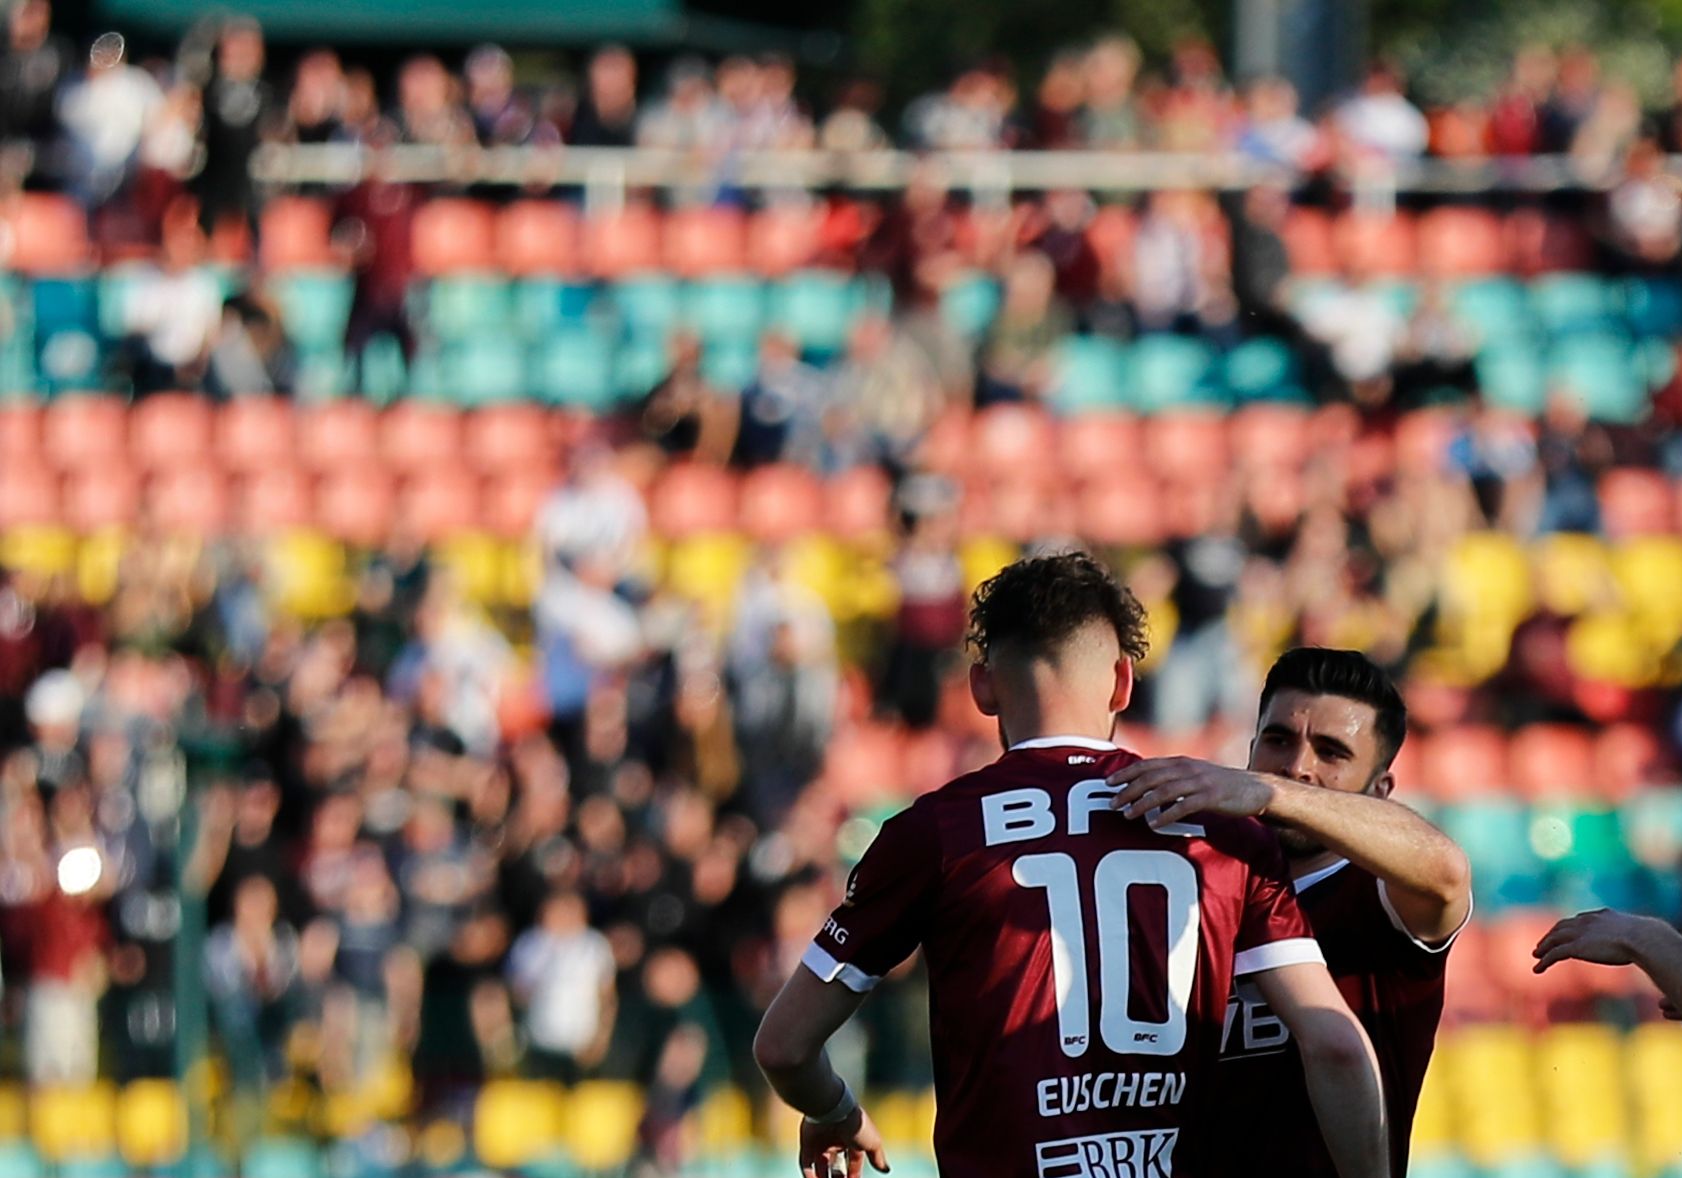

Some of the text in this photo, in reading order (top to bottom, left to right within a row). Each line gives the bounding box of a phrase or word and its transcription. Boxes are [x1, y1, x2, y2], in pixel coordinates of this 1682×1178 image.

[1011, 849, 1200, 1058] 10
[1063, 1035, 1086, 1046] BFC
[1133, 1033, 1158, 1043] BFC
[1036, 1071, 1187, 1117] EUSCHEN
